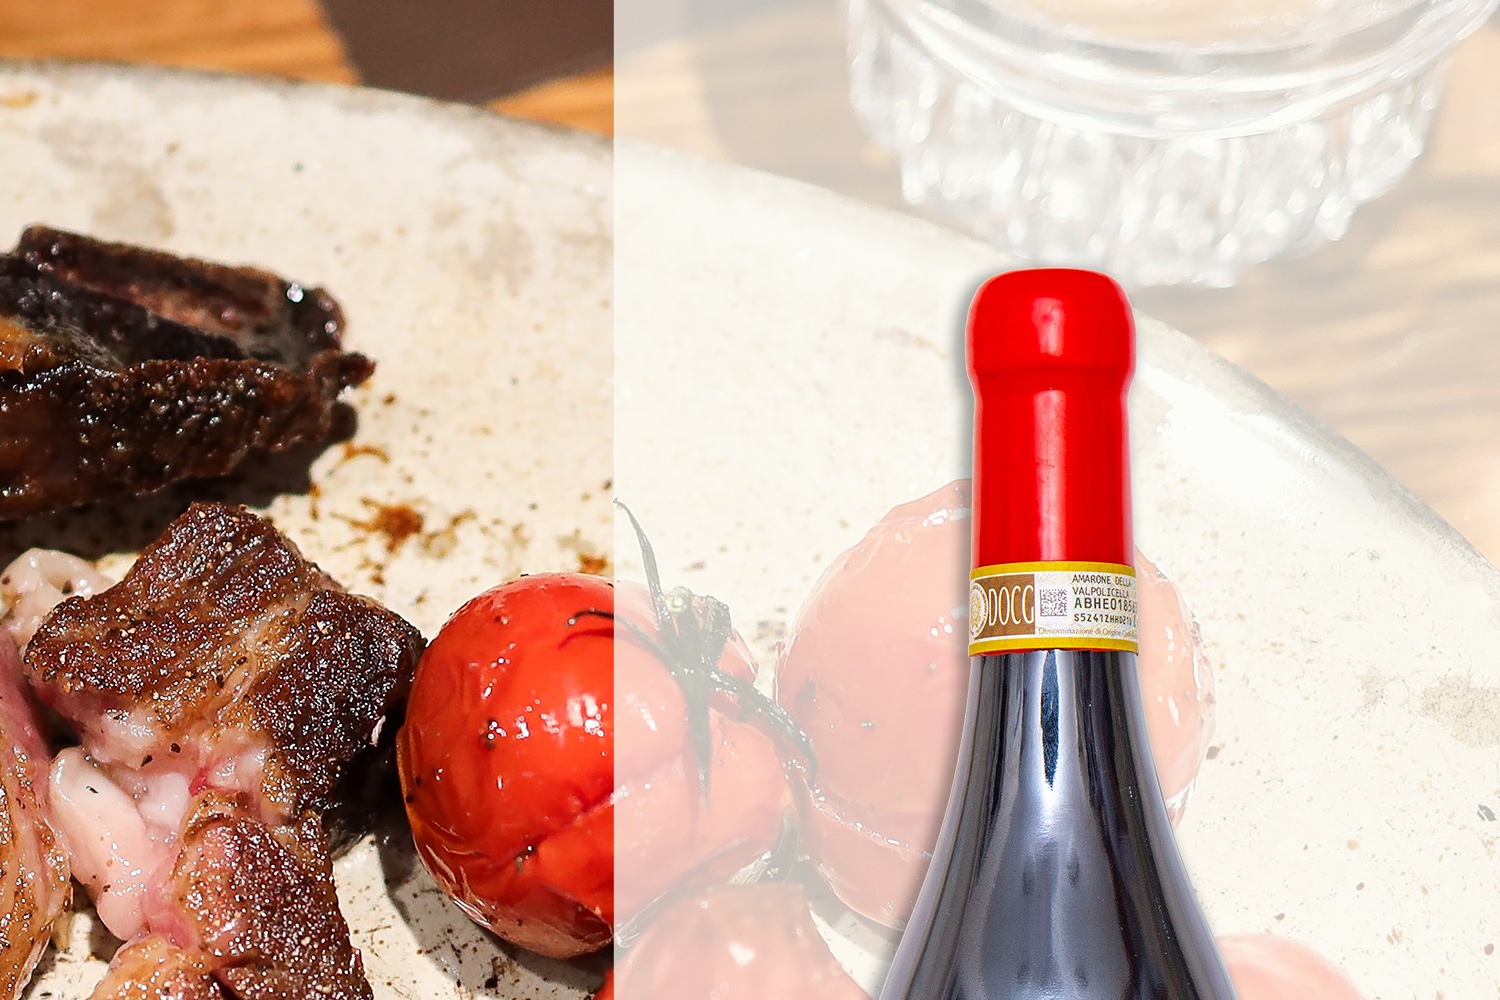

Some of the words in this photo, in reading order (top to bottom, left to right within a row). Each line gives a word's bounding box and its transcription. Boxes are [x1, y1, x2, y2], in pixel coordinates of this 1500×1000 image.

[1072, 574, 1112, 585] AMARONE
[1072, 586, 1130, 599] VALPOLICELLA
[988, 584, 1035, 627] DOCG
